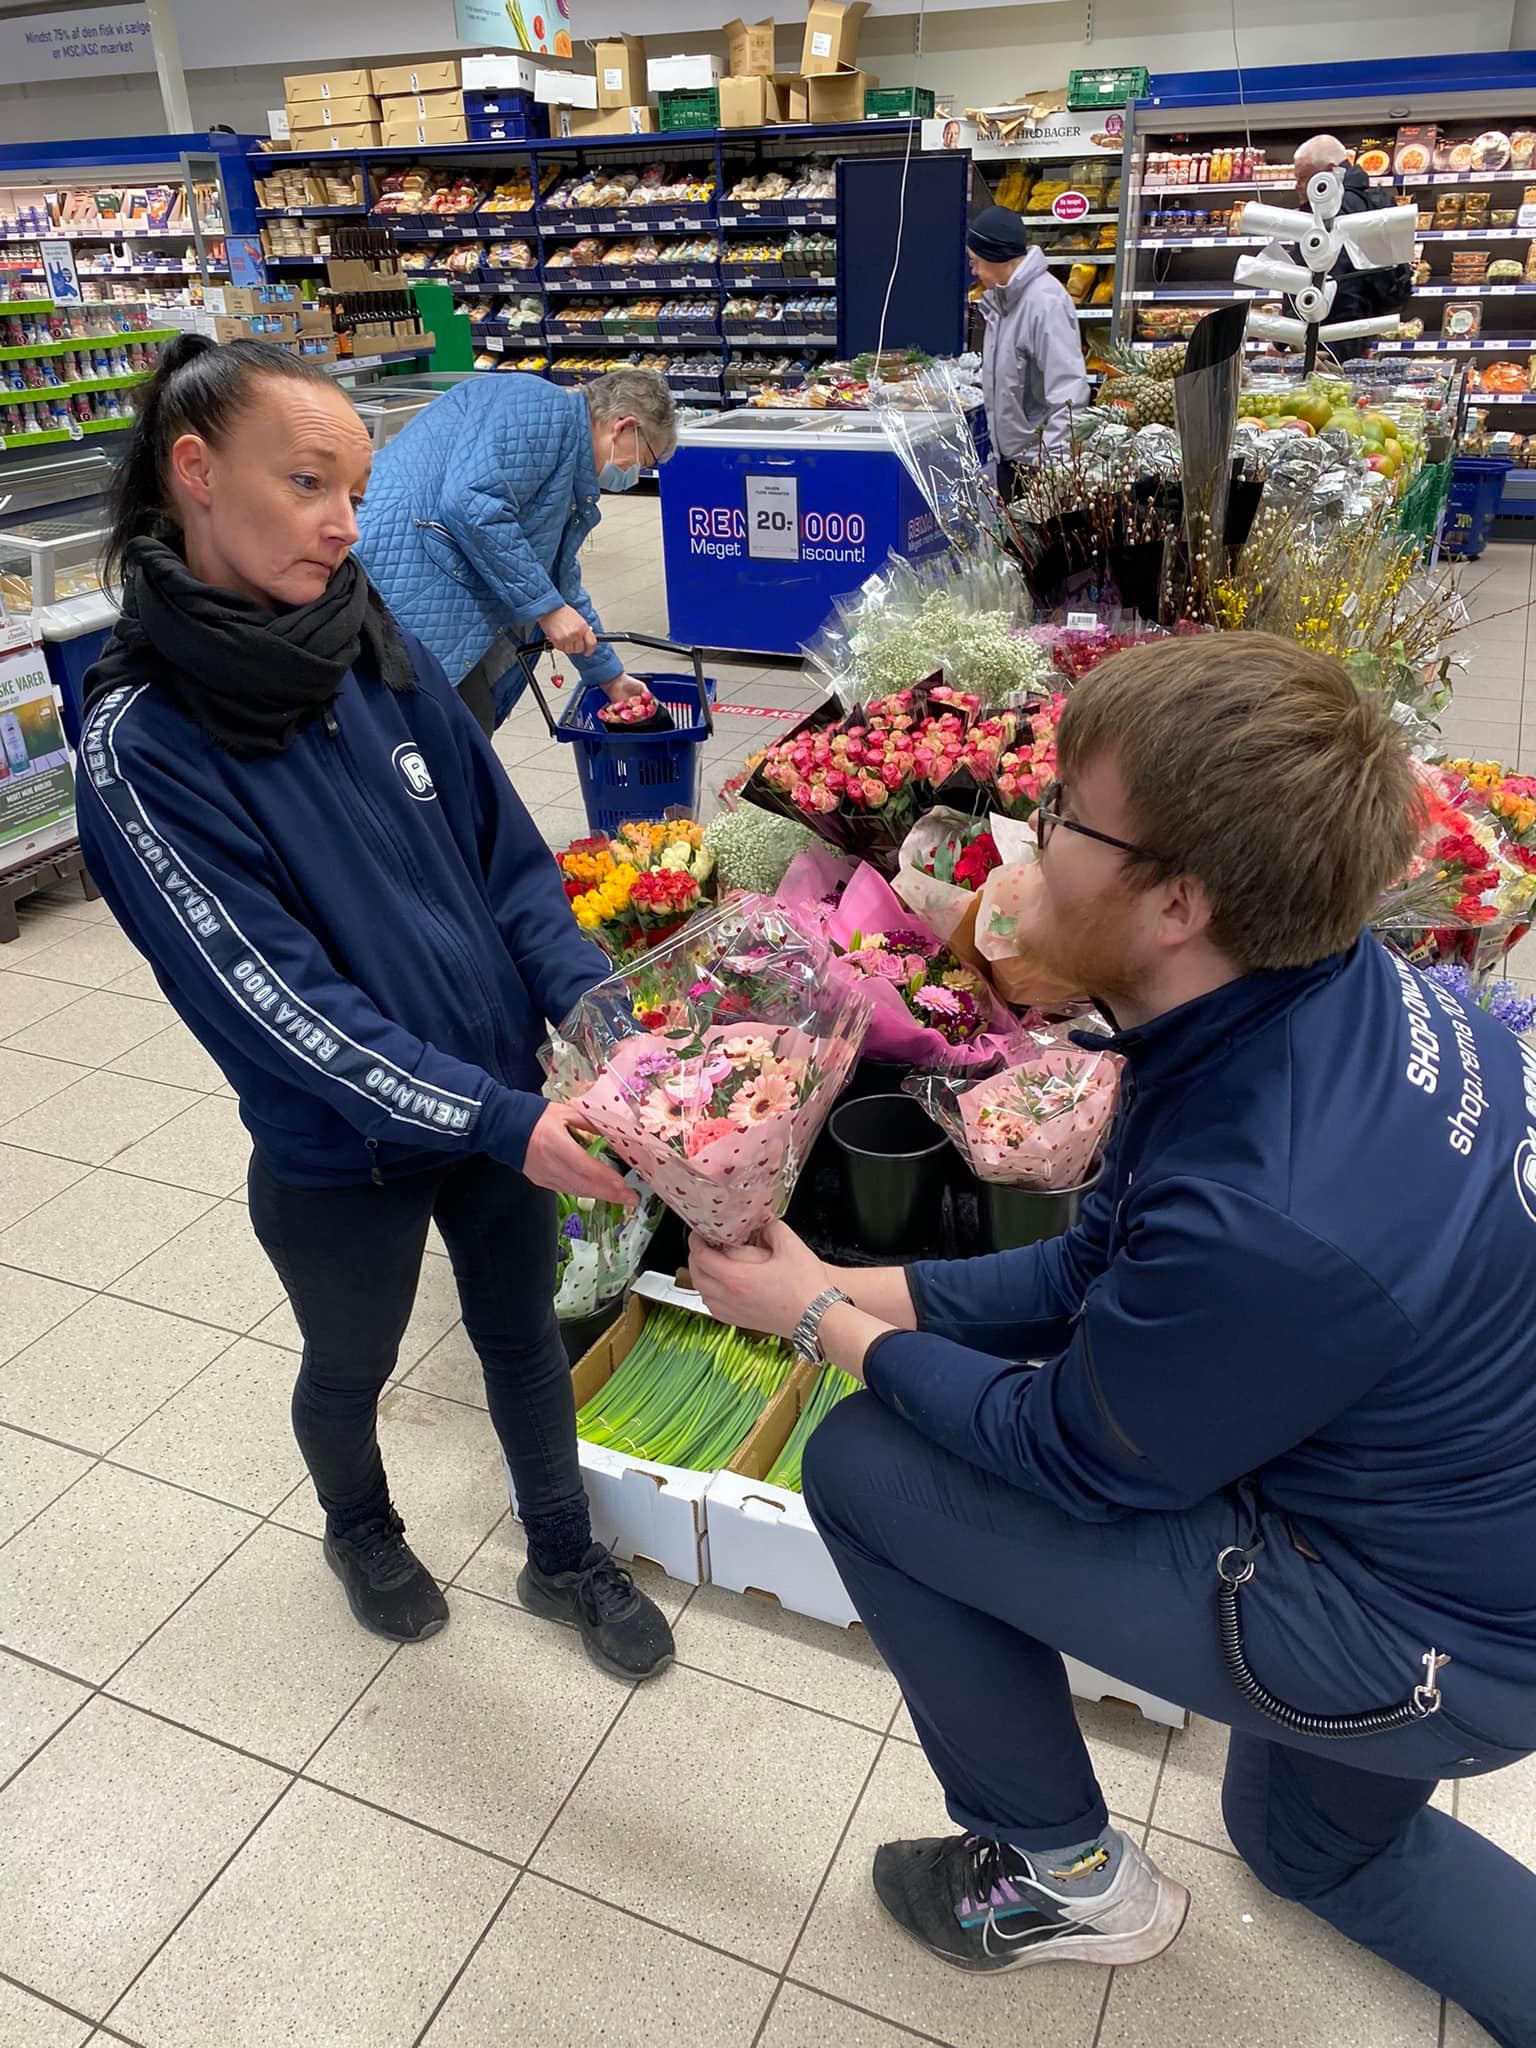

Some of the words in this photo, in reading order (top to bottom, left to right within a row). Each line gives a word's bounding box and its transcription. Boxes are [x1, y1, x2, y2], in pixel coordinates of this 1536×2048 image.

[25, 32, 51, 44] Mindst
[53, 28, 71, 41] 75%
[71, 26, 80, 40] af
[82, 26, 98, 38] den
[99, 23, 115, 37] fisk
[116, 22, 124, 35] vi
[125, 20, 151, 36] sælge
[52, 50, 61, 59] er
[63, 43, 99, 57] MSC/ASC
[100, 41, 134, 54] mærket
[1044, 125, 1081, 139] BAGER
[690, 537, 742, 560] Meget
[802, 543, 865, 563] iscount!
[15, 671, 46, 692] VARER
[718, 704, 765, 716] HOLD
[86, 712, 116, 788] REMA
[125, 820, 171, 875] 1000
[164, 869, 222, 938] REMA
[232, 960, 280, 1012] 1000
[273, 1001, 341, 1063] REMA
[1406, 1013, 1441, 1094] SHOP
[397, 1085, 471, 1129] REMA
